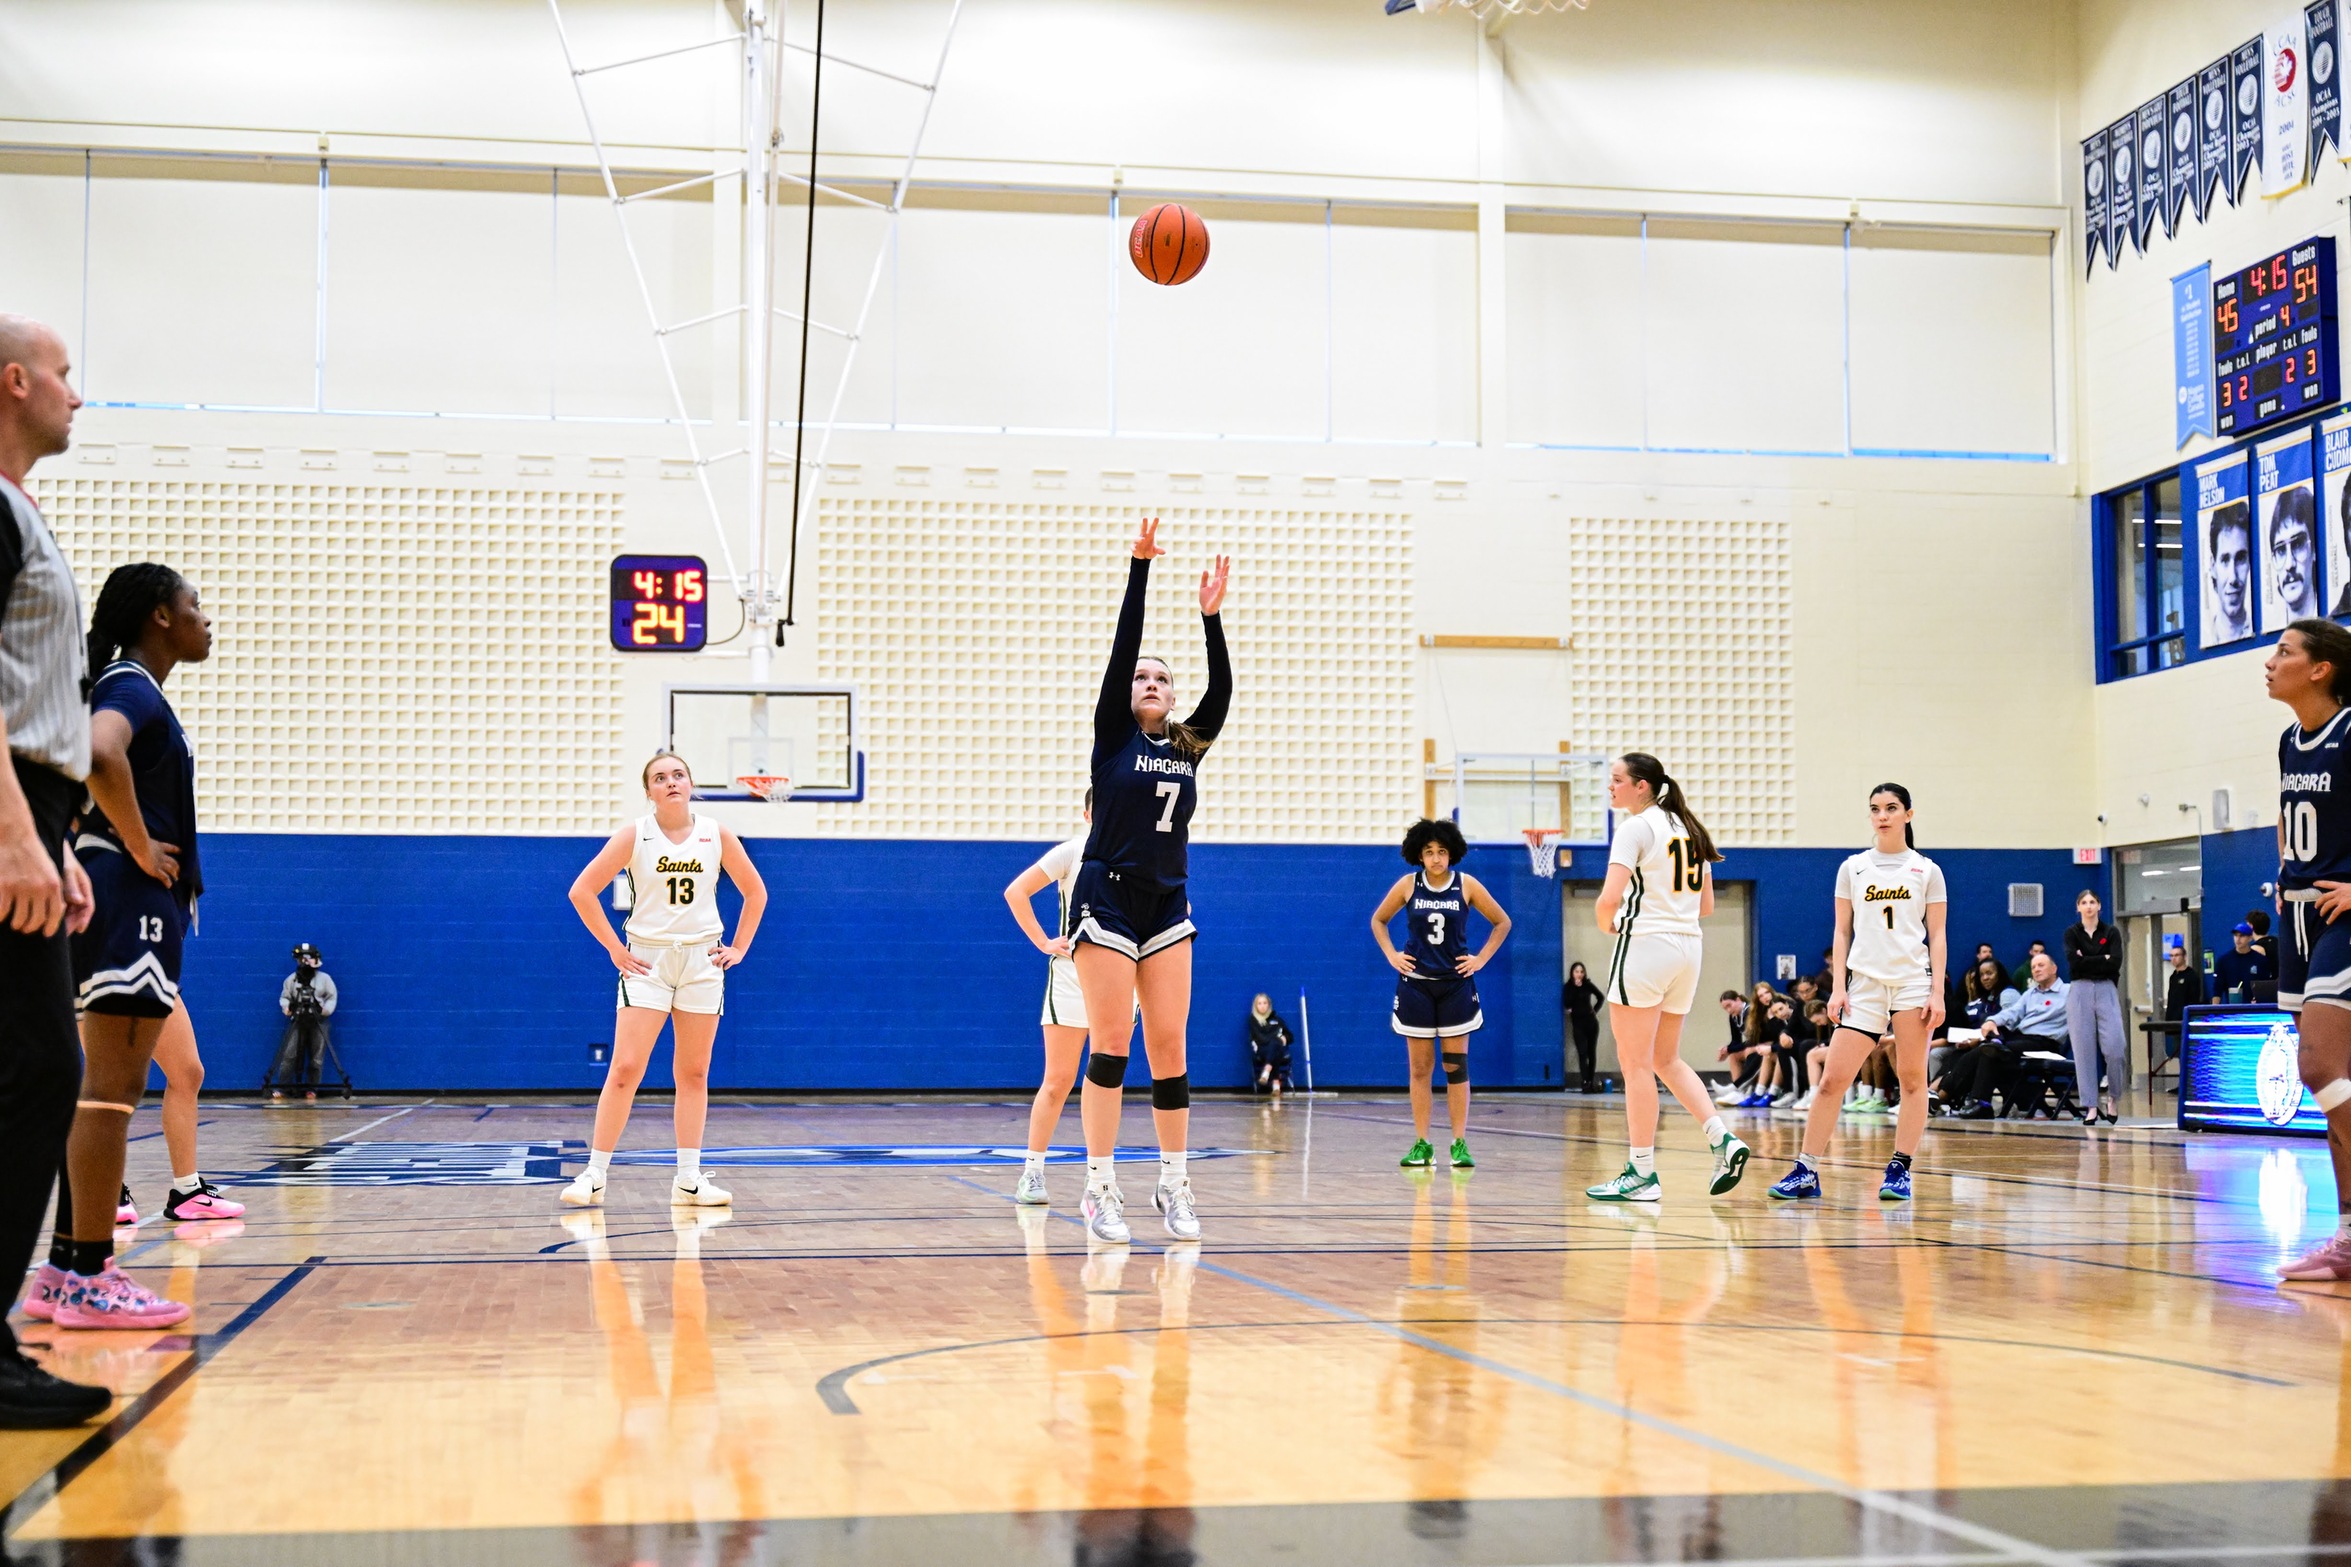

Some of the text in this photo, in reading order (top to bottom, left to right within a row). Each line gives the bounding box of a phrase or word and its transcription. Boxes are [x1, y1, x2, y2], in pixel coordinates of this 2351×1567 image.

[2312, 97, 2339, 117] Champions
[2292, 245, 2316, 267] Guests
[2250, 254, 2288, 296] 4:15
[2294, 264, 2317, 304] 54
[2217, 281, 2235, 300] Home
[2217, 298, 2239, 333] 45
[2255, 314, 2276, 339] period
[2280, 304, 2290, 327] 4
[2301, 325, 2318, 344] fouls
[2256, 342, 2277, 364] player
[2307, 349, 2316, 375] 3
[2218, 360, 2233, 377] fouls
[2285, 357, 2295, 383] 2
[2223, 382, 2232, 407] 3
[2238, 375, 2249, 401] 2
[2304, 383, 2318, 399] won
[2259, 399, 2276, 418] game
[2220, 415, 2233, 430] won
[2325, 429, 2350, 453] BLAIR
[2259, 454, 2276, 475] TOM
[2199, 472, 2218, 493] MARK
[2259, 470, 2280, 493] PEAT
[2200, 486, 2225, 509] NELSON
[634, 571, 703, 602] 4:15
[633, 603, 684, 644] 24
[1134, 754, 1194, 778] NIAGARA
[1155, 781, 1181, 832] 7
[2283, 801, 2317, 862] 10
[656, 855, 703, 873] Saints
[1667, 837, 1704, 894] 15
[2079, 848, 2096, 861] EXIT
[666, 877, 694, 905] 13
[1864, 884, 1912, 902] Saints
[1414, 898, 1460, 911] NIAGARA
[138, 915, 163, 942] 13
[1427, 913, 1446, 945] 3
[1882, 905, 1894, 930] 1
